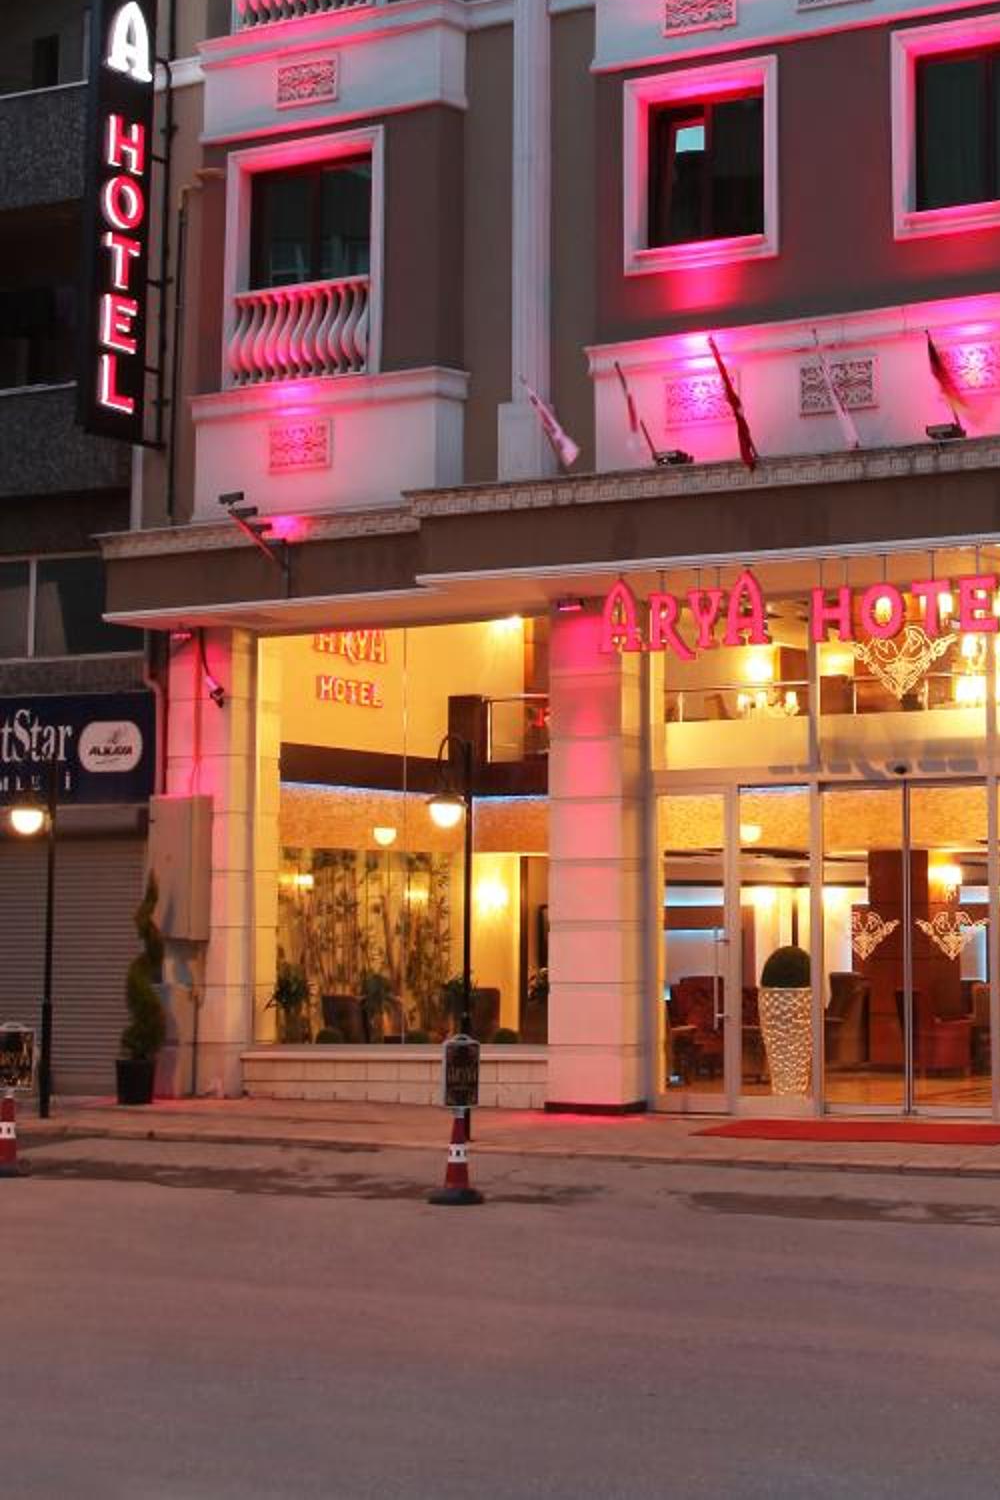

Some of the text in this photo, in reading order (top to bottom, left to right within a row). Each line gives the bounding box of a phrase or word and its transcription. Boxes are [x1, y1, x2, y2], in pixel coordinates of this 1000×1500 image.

[100, 114, 146, 415] HOTEL
[599, 570, 769, 660] ARYA
[317, 675, 385, 709] HOTEL
